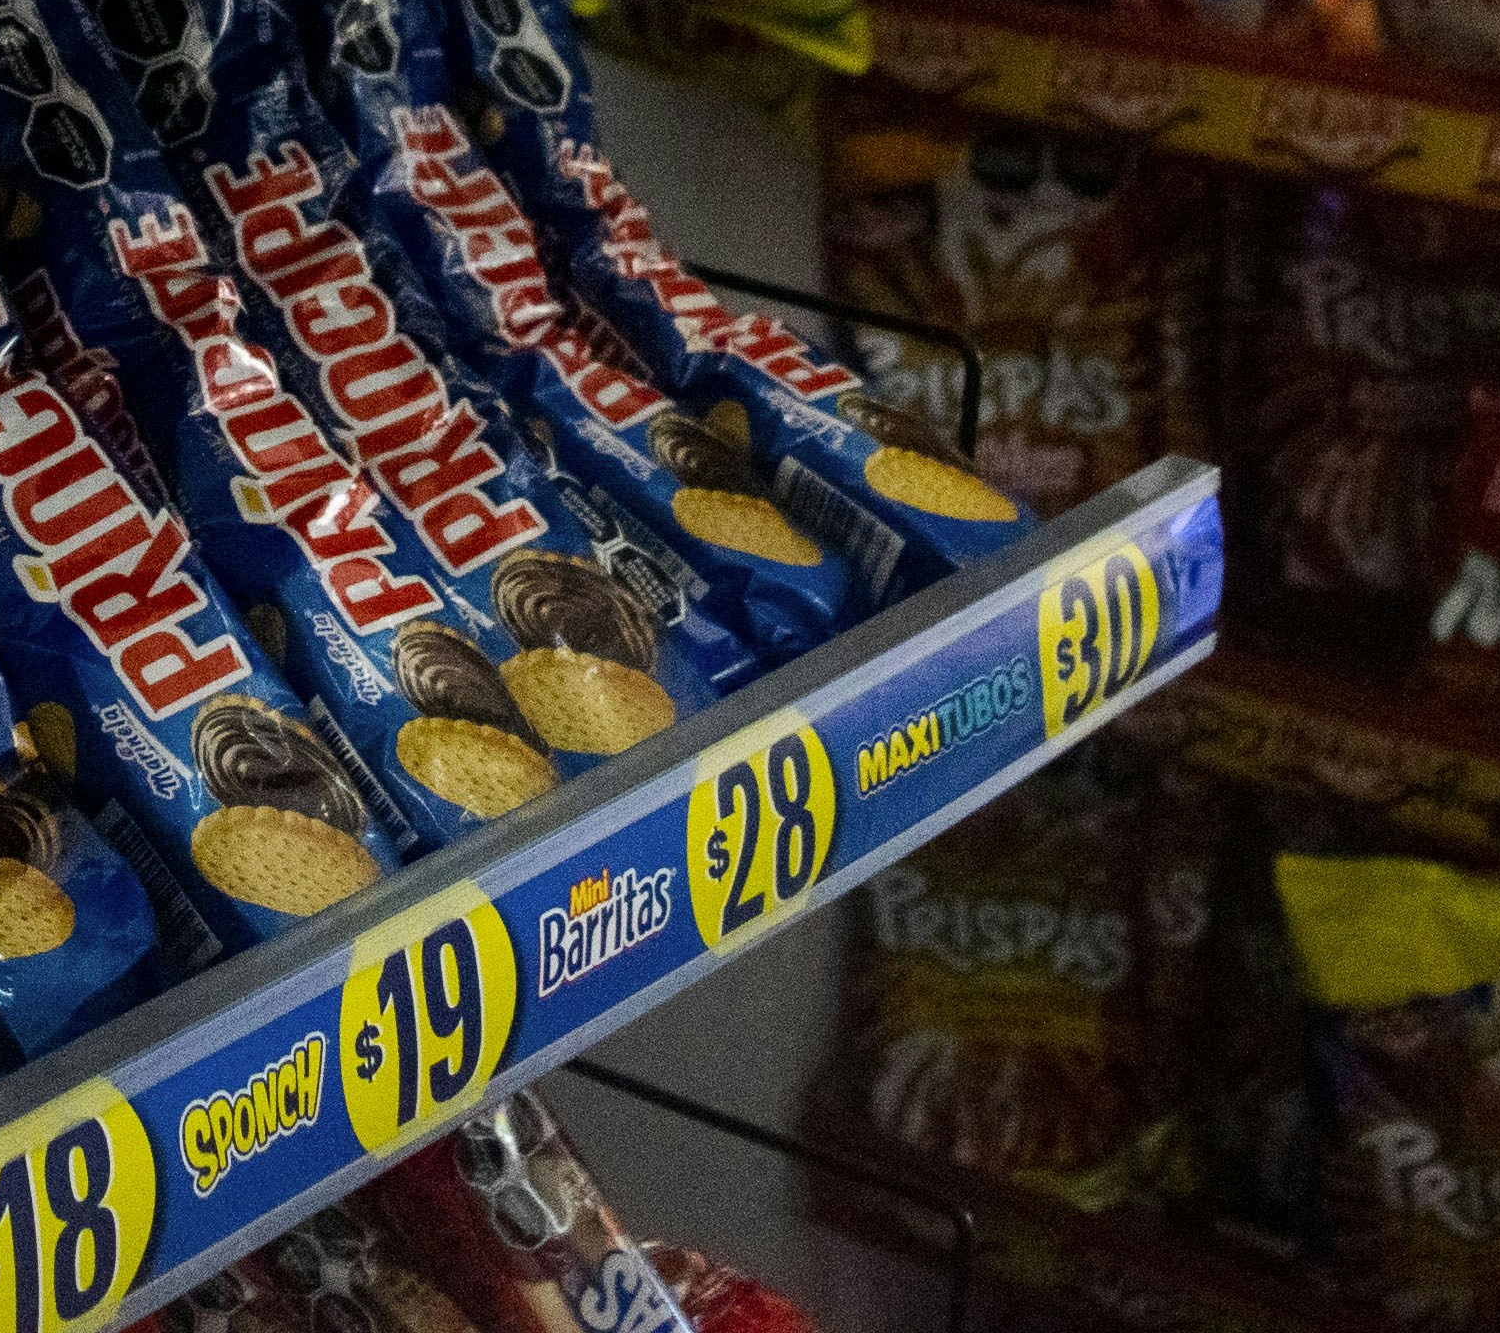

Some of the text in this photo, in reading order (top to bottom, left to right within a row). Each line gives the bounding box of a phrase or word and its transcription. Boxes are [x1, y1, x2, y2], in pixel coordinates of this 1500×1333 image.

[87, 699, 193, 801] Marinela
[854, 551, 1147, 799] MAXITUBOS $30
[538, 733, 815, 998] Barritas $28
[567, 867, 611, 915] Mini
[180, 914, 487, 1198] SPONCH $19
